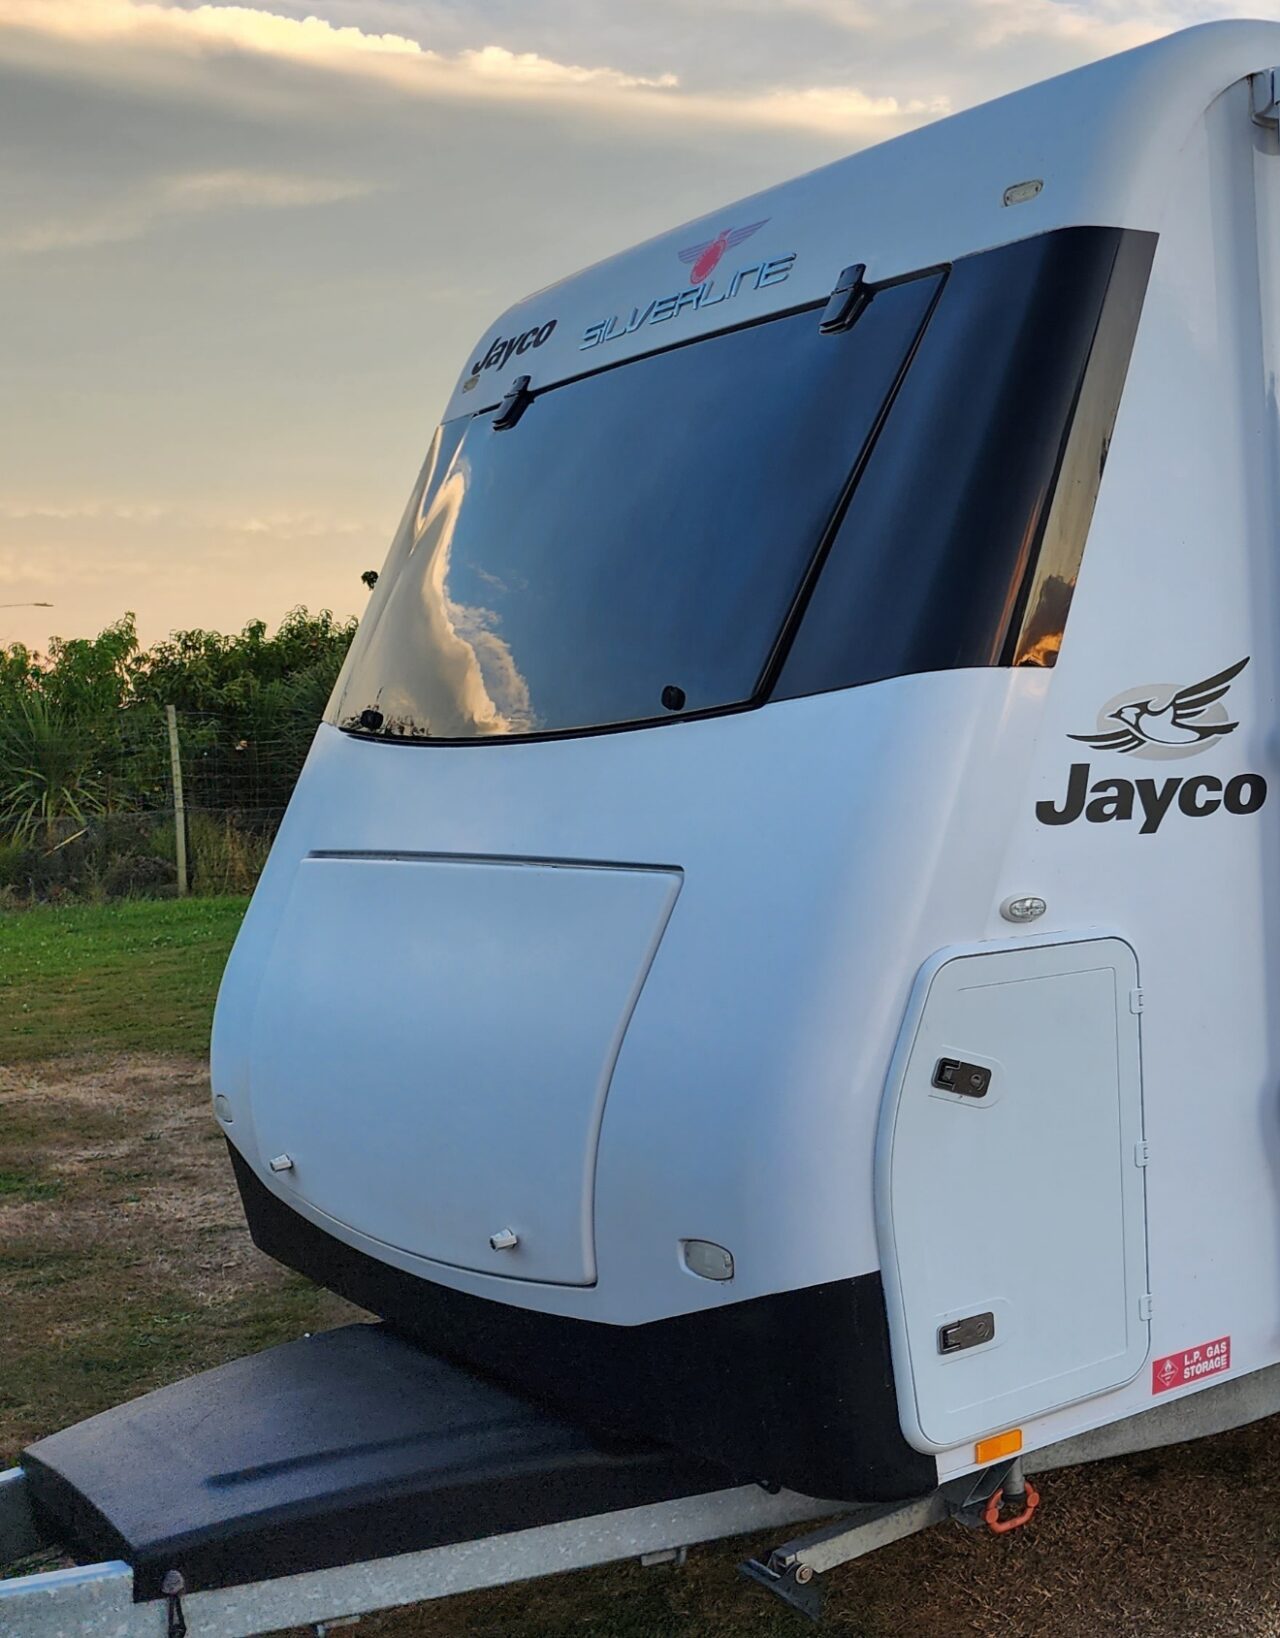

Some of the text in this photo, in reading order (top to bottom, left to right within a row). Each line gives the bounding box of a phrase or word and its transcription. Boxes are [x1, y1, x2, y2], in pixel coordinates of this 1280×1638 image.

[471, 252, 797, 376] Jayco SILVERLINE
[1035, 763, 1267, 834] Jayco
[1183, 1354, 1228, 1379] STORAGE
[1206, 1341, 1227, 1358] GAS
